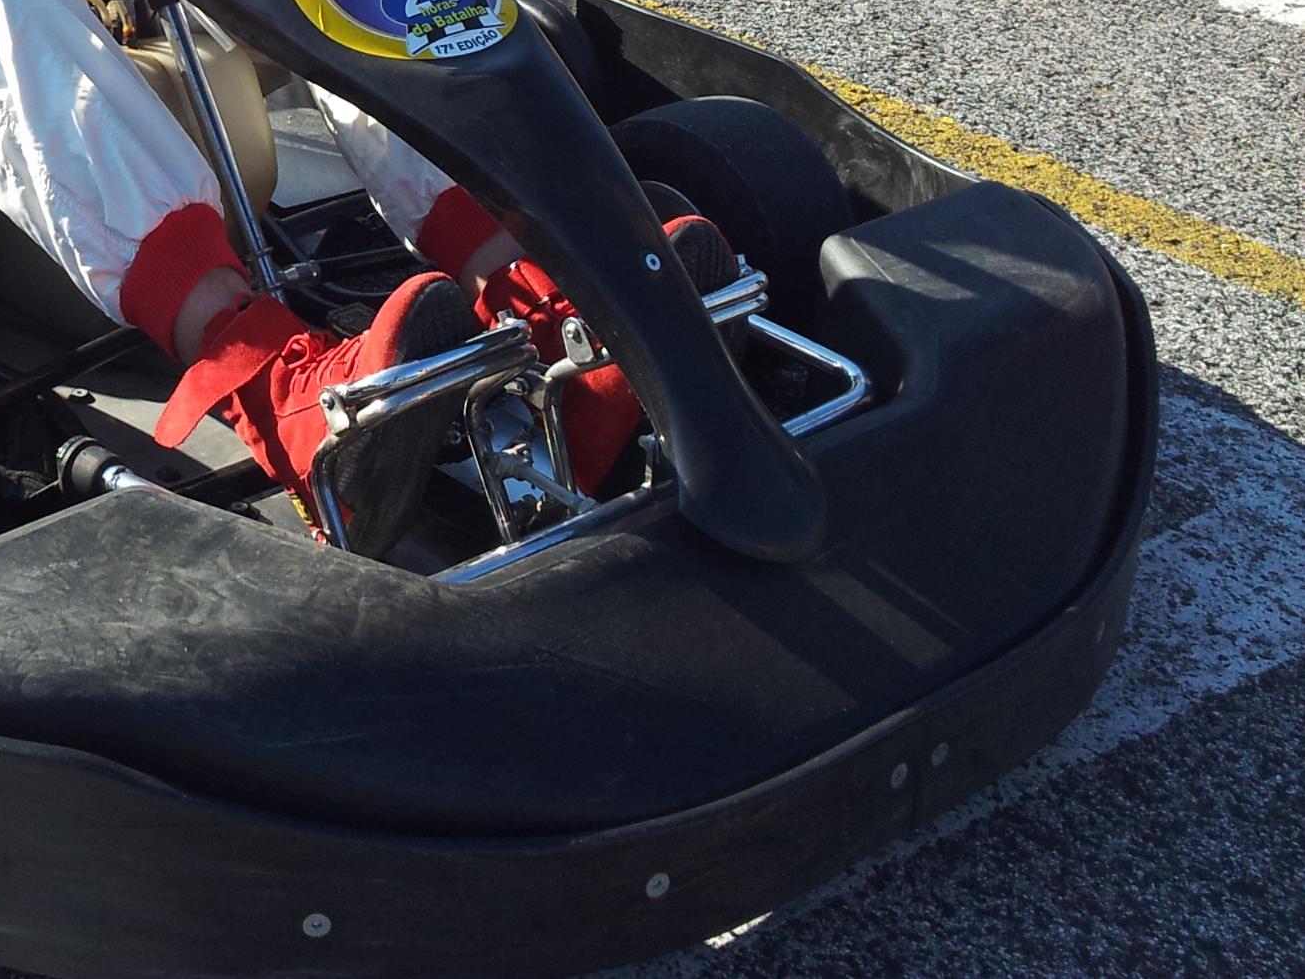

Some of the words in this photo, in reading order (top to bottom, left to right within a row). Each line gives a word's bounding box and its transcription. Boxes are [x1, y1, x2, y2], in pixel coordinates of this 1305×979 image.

[412, 22, 433, 36] da
[432, 3, 487, 28] Batalha
[458, 28, 499, 52] EDIÇÃO
